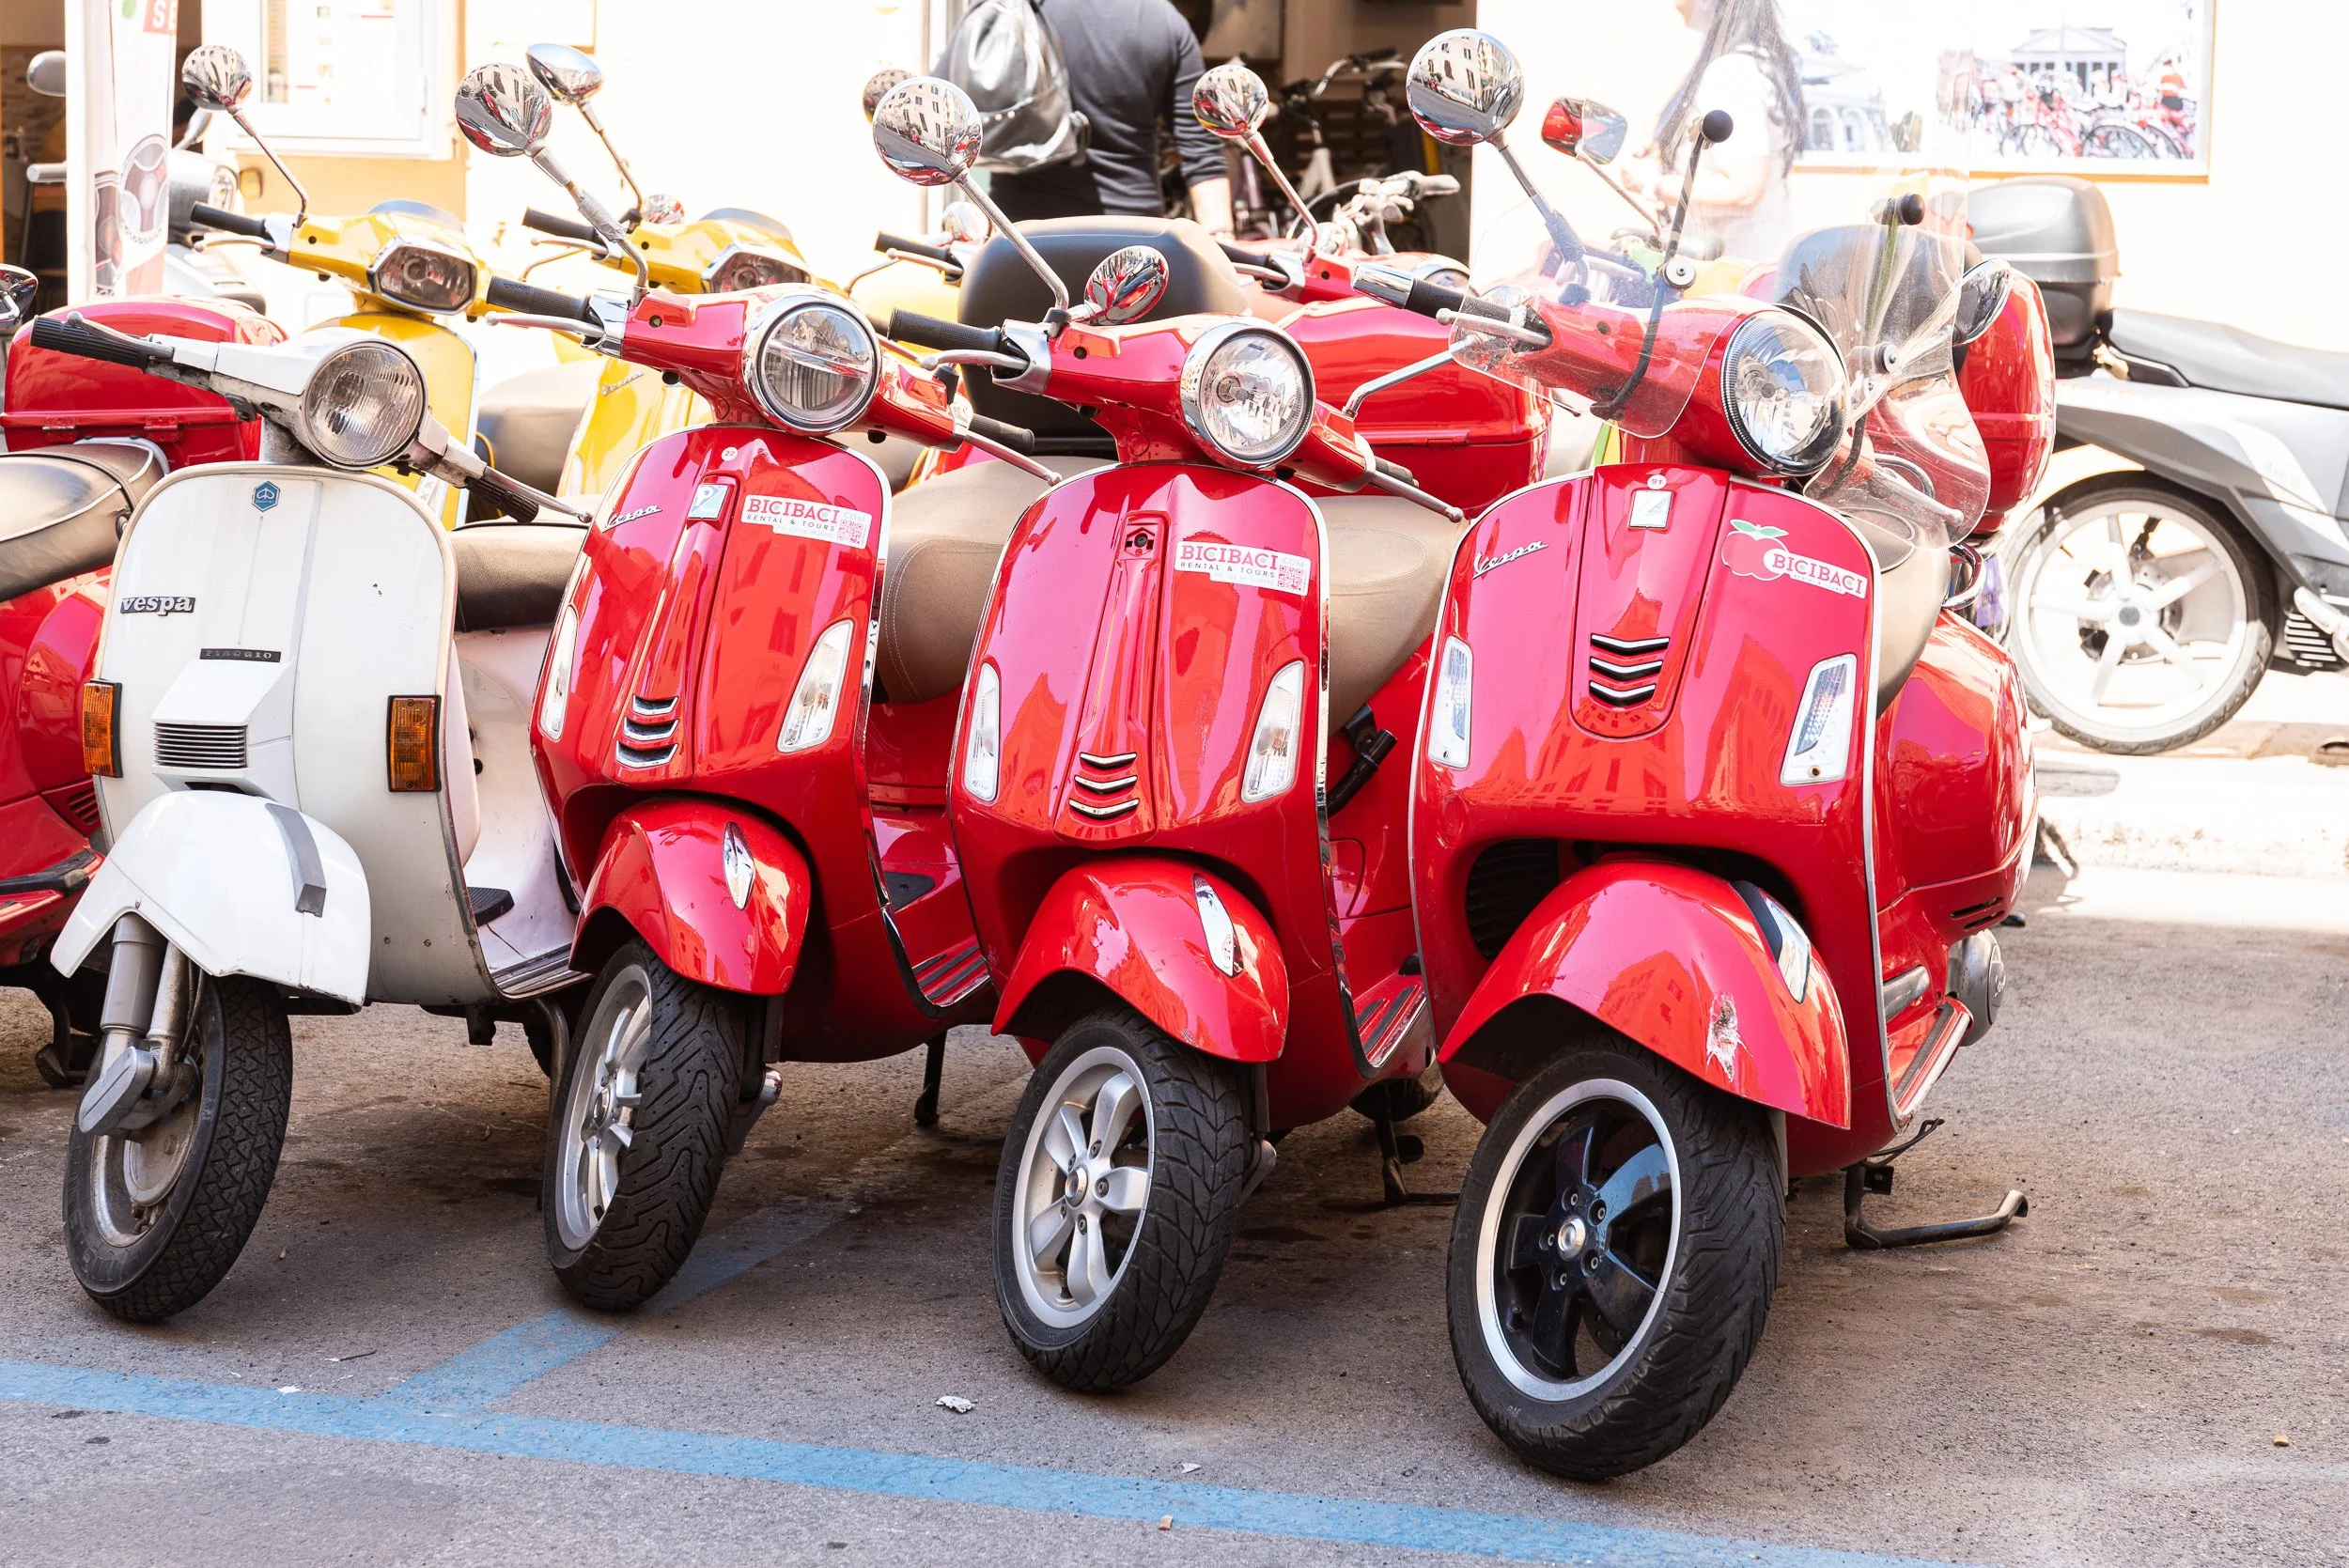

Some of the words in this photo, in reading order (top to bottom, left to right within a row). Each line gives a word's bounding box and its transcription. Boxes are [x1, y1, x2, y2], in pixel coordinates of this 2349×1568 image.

[602, 504, 662, 533] Vespa
[746, 514, 784, 523] RENTAL
[802, 520, 835, 532] TOURS
[747, 498, 840, 524] BICIBACI
[1180, 545, 1279, 569] BICIBACI
[1180, 561, 1220, 570] RENTAL
[1240, 567, 1275, 578] TOURS
[1472, 540, 1548, 580] Vespa
[1772, 552, 1862, 595] BICIBACI
[122, 596, 194, 616] vespa
